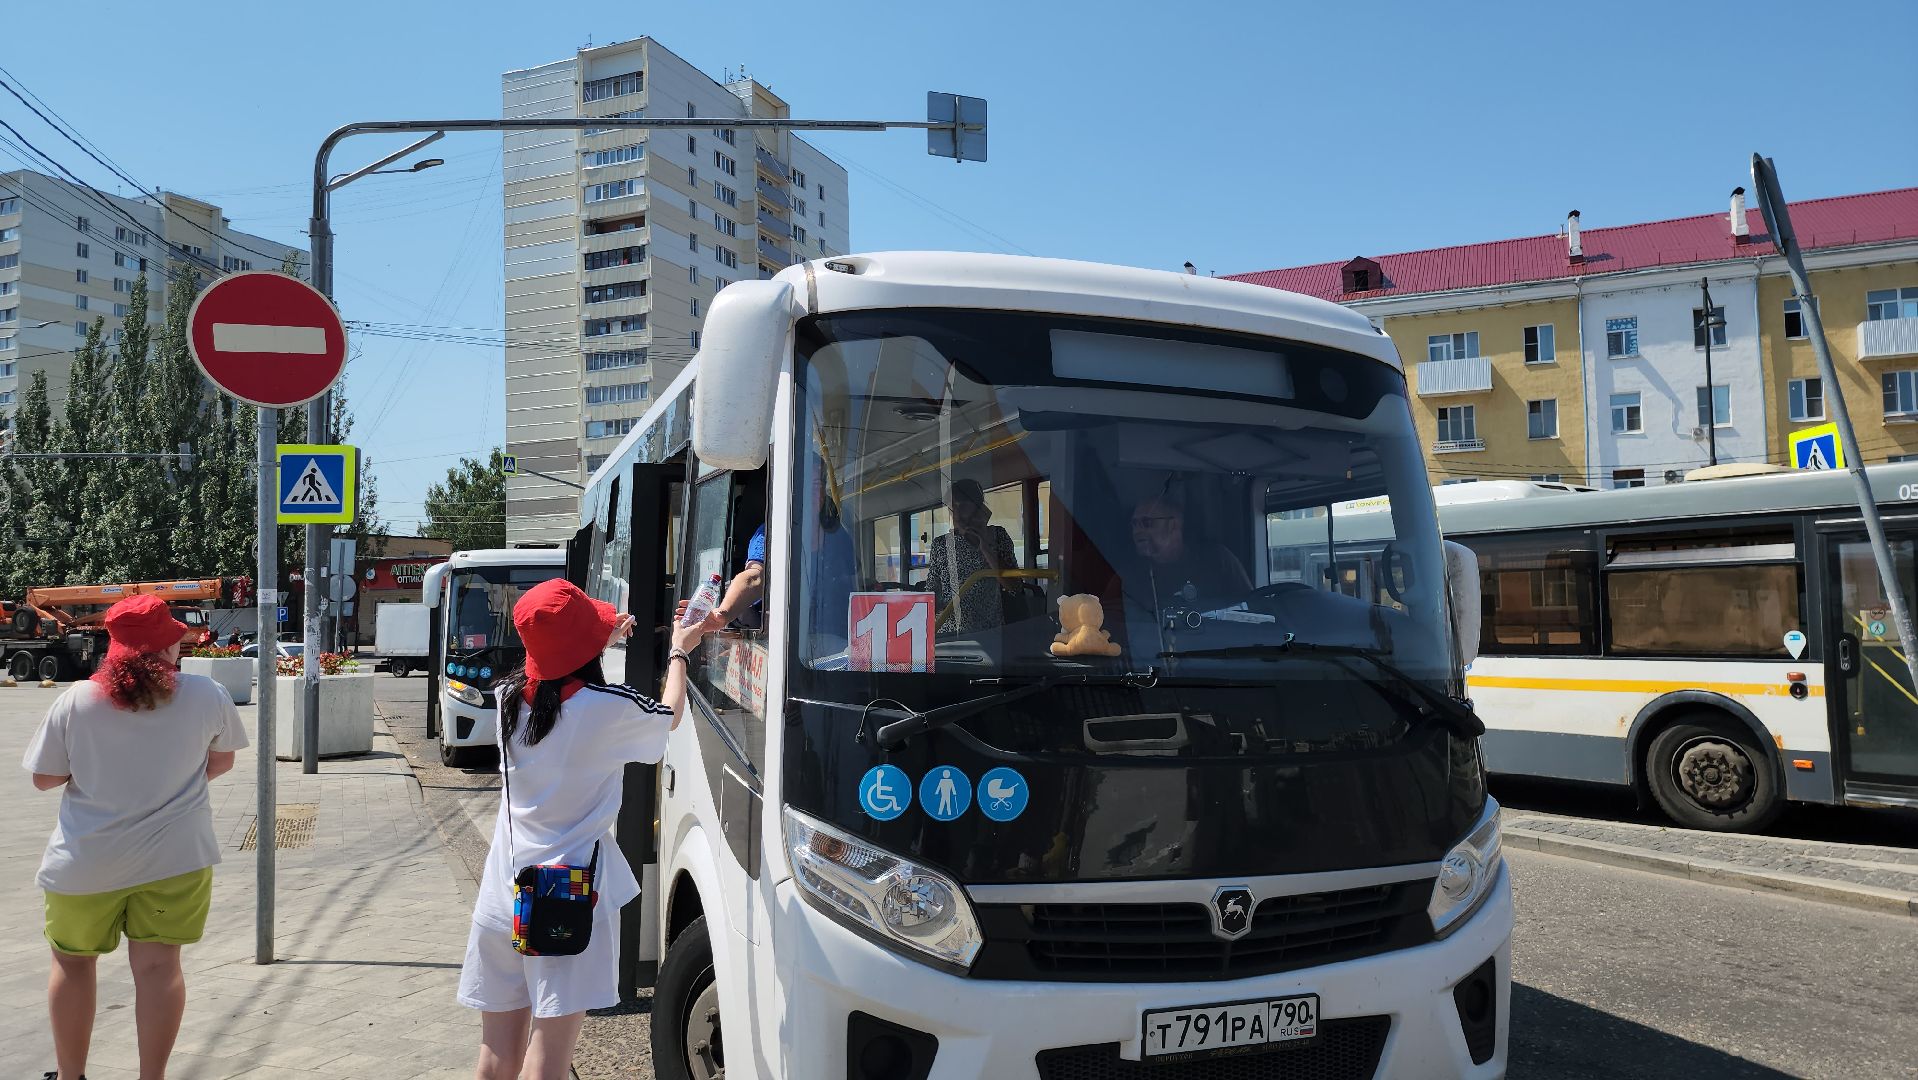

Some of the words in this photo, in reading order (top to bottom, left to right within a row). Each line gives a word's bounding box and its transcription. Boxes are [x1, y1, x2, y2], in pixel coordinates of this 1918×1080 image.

[279, 608, 287, 621] P
[466, 637, 475, 649] 5
[856, 602, 929, 673] 11
[1157, 1011, 1264, 1049] Т791РА
[1271, 1001, 1310, 1028] 790
[1281, 1026, 1299, 1037] RUS
